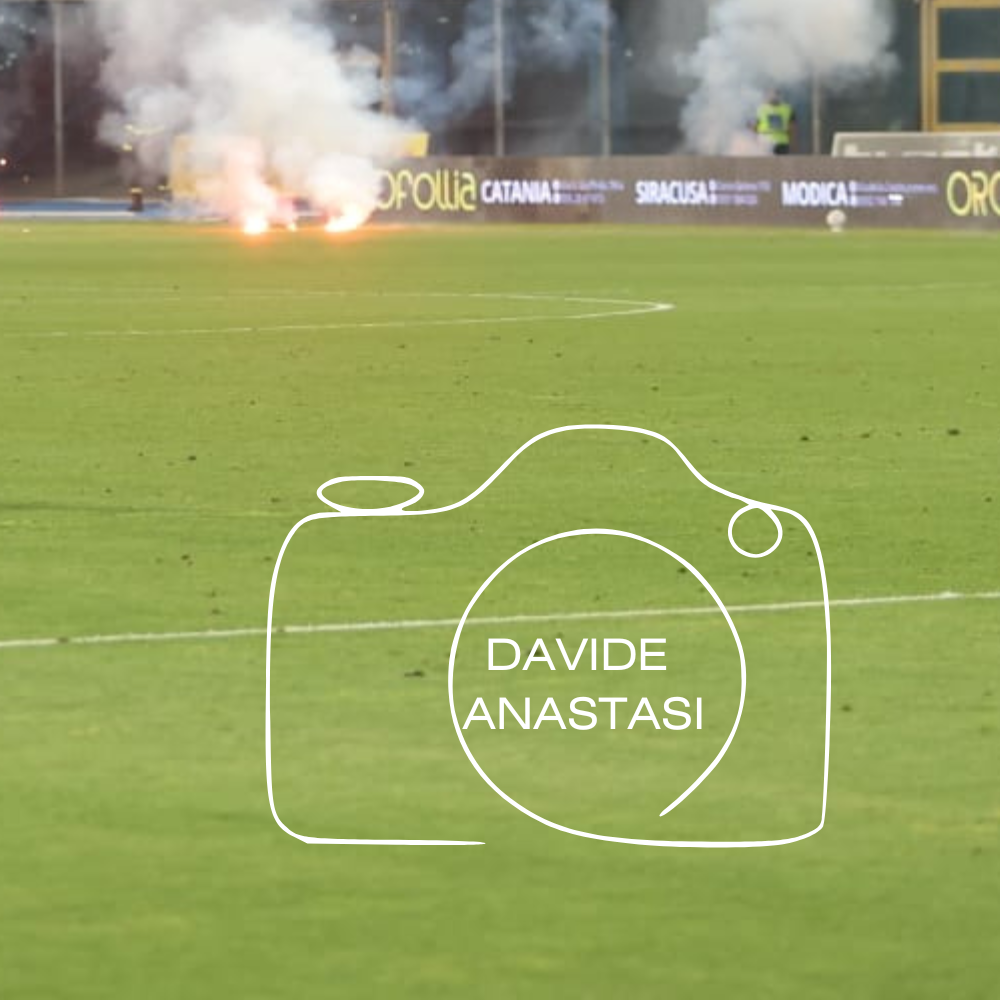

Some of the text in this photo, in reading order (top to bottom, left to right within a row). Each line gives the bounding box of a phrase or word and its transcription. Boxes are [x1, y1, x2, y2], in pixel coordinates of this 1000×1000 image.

[480, 179, 552, 204] CATANIA
[635, 180, 709, 205] SIRACUSA
[782, 180, 849, 206] MODICA
